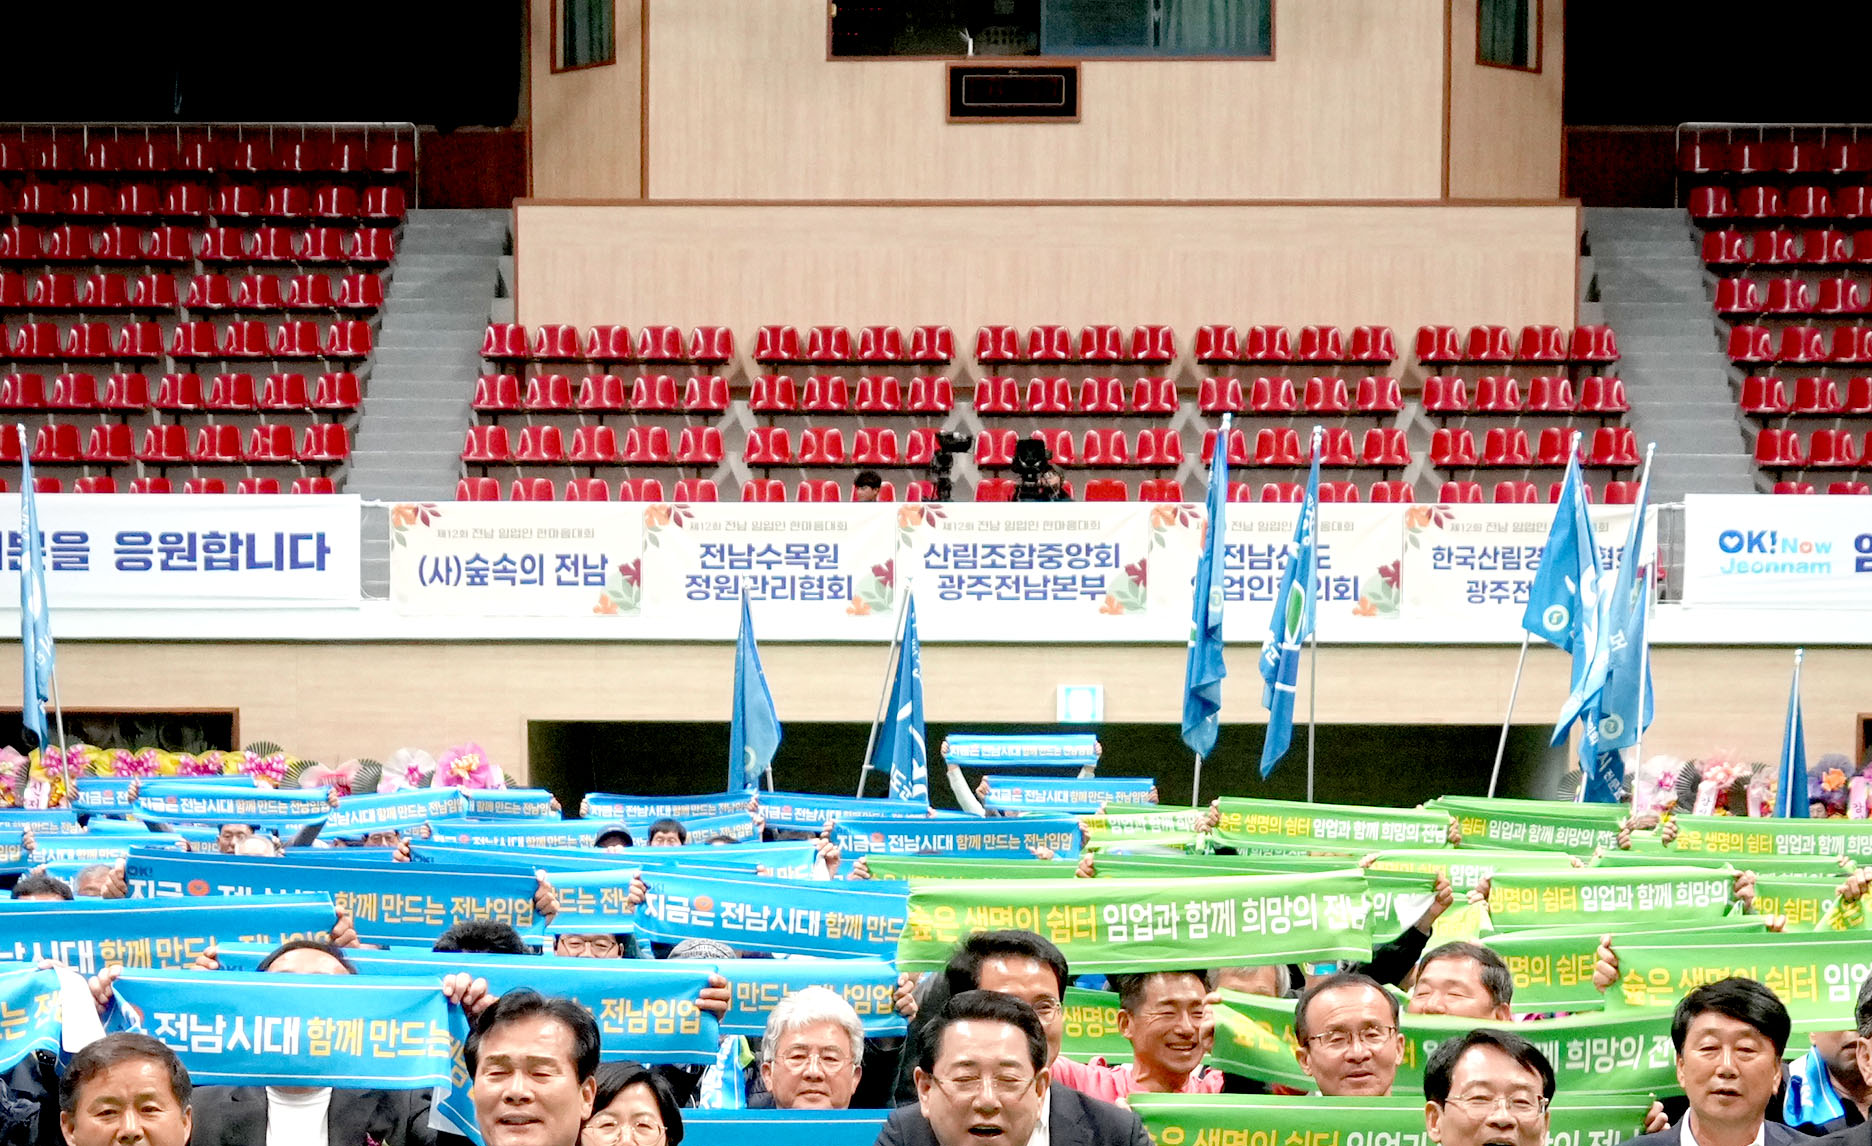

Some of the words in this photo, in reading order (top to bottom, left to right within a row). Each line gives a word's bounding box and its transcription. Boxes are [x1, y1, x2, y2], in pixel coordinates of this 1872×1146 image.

[471, 526, 494, 540] 전남
[498, 526, 532, 540] 임업인
[536, 527, 595, 540] 한마음대회
[724, 519, 748, 532] 전남
[751, 519, 786, 532] 임업인
[789, 519, 848, 532] 한마음대회
[977, 519, 1001, 532] 전남
[1004, 519, 1038, 532] 임업인
[1042, 519, 1101, 532] 한마음대회
[113, 527, 330, 573] 응원합니다
[698, 542, 840, 570] 전남수목원
[923, 542, 1120, 570] 산림조합중앙회
[1718, 529, 1778, 556] OK!
[1780, 536, 1832, 556] Now
[417, 552, 549, 588] (사)숲속의
[555, 553, 609, 588] 전남
[1720, 557, 1832, 575] Jeonnam
[684, 572, 854, 602] 정원관리협회
[937, 572, 1108, 602] 광주전남본부
[839, 832, 886, 852] 지금은
[889, 833, 953, 852] 전남시대
[955, 833, 981, 852] 함께
[984, 833, 1020, 852] 만드는
[1244, 813, 1282, 837] 생명의
[1285, 815, 1310, 838] 쉼터
[1313, 817, 1351, 841] 임업과
[1353, 819, 1379, 841] 함께
[1382, 819, 1419, 843] 희망의
[1675, 831, 1702, 852] 숲은
[1705, 830, 1743, 853] 생명의
[1745, 830, 1773, 854] 쉼터
[1776, 832, 1816, 855] 임업과
[1819, 833, 1846, 855] 함께
[645, 893, 716, 928] 지금은
[720, 899, 821, 936] 전남시대
[825, 910, 863, 938] 함께
[1046, 903, 1097, 943] 쉼터
[1104, 904, 1180, 942] 임업과
[1185, 899, 1237, 938] 함께
[1242, 894, 1319, 935] 희망의
